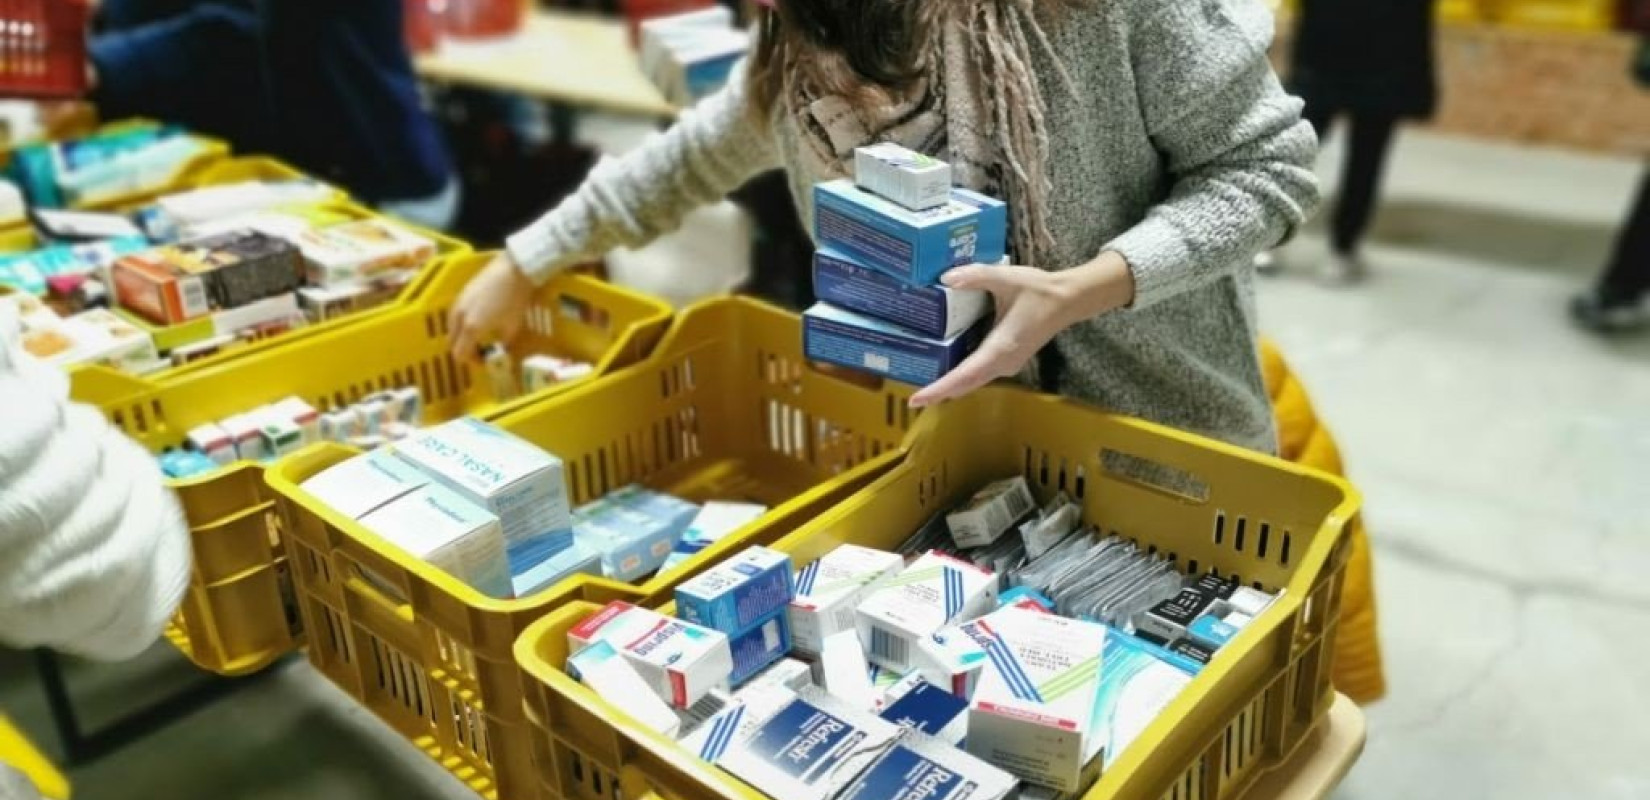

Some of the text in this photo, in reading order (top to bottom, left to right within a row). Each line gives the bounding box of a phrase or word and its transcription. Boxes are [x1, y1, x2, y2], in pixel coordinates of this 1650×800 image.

[960, 623, 992, 649] spring
[788, 717, 845, 764] Refresh
[902, 766, 953, 800] Refre
